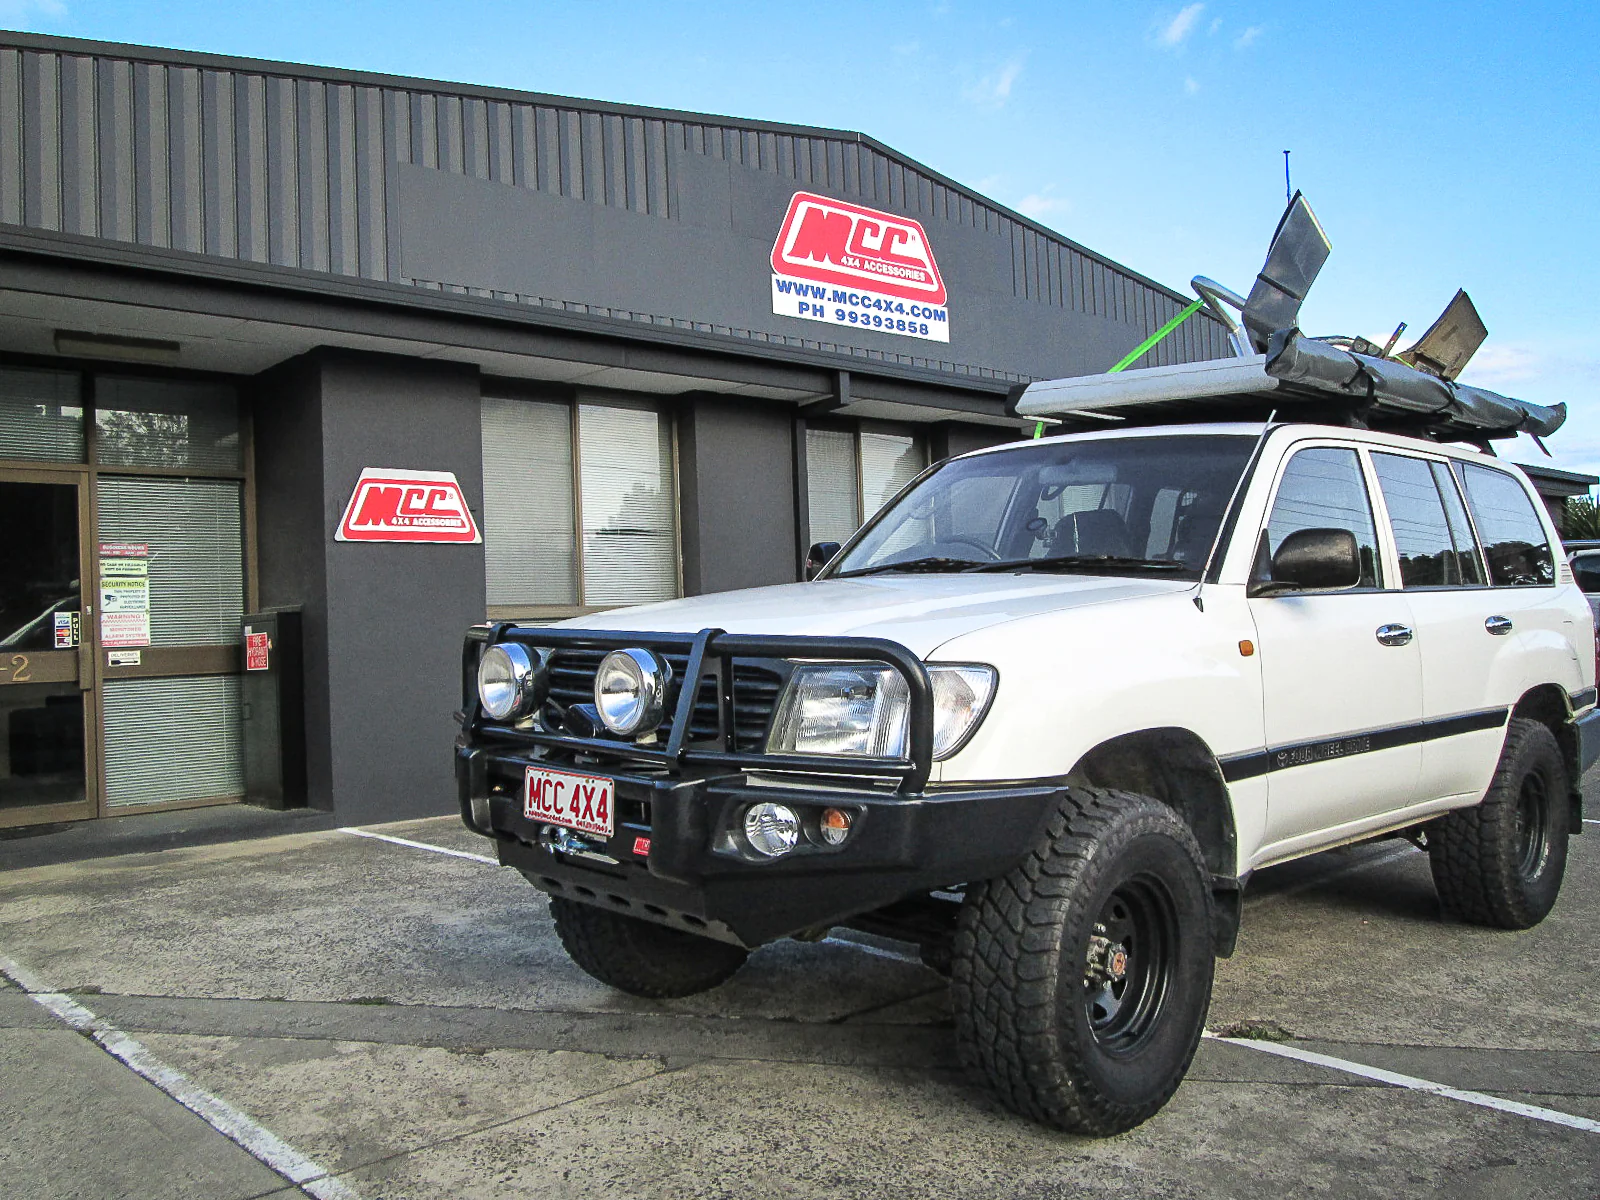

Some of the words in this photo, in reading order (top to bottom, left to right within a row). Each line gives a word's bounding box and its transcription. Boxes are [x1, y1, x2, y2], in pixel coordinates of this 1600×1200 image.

[787, 206, 927, 270] MCC
[840, 256, 860, 269] 4X4
[864, 260, 926, 282] ACCESSORIES
[775, 278, 947, 323] WWW.MCC4X4.COM
[798, 302, 825, 319] PH
[834, 308, 929, 336] 99393858
[353, 486, 461, 526] MCC
[391, 516, 410, 526] 4X4
[412, 518, 462, 528] ACCESSORIES
[1314, 741, 1344, 760] WHEEL
[529, 776, 565, 815] MCC
[569, 784, 609, 825] 4X4
